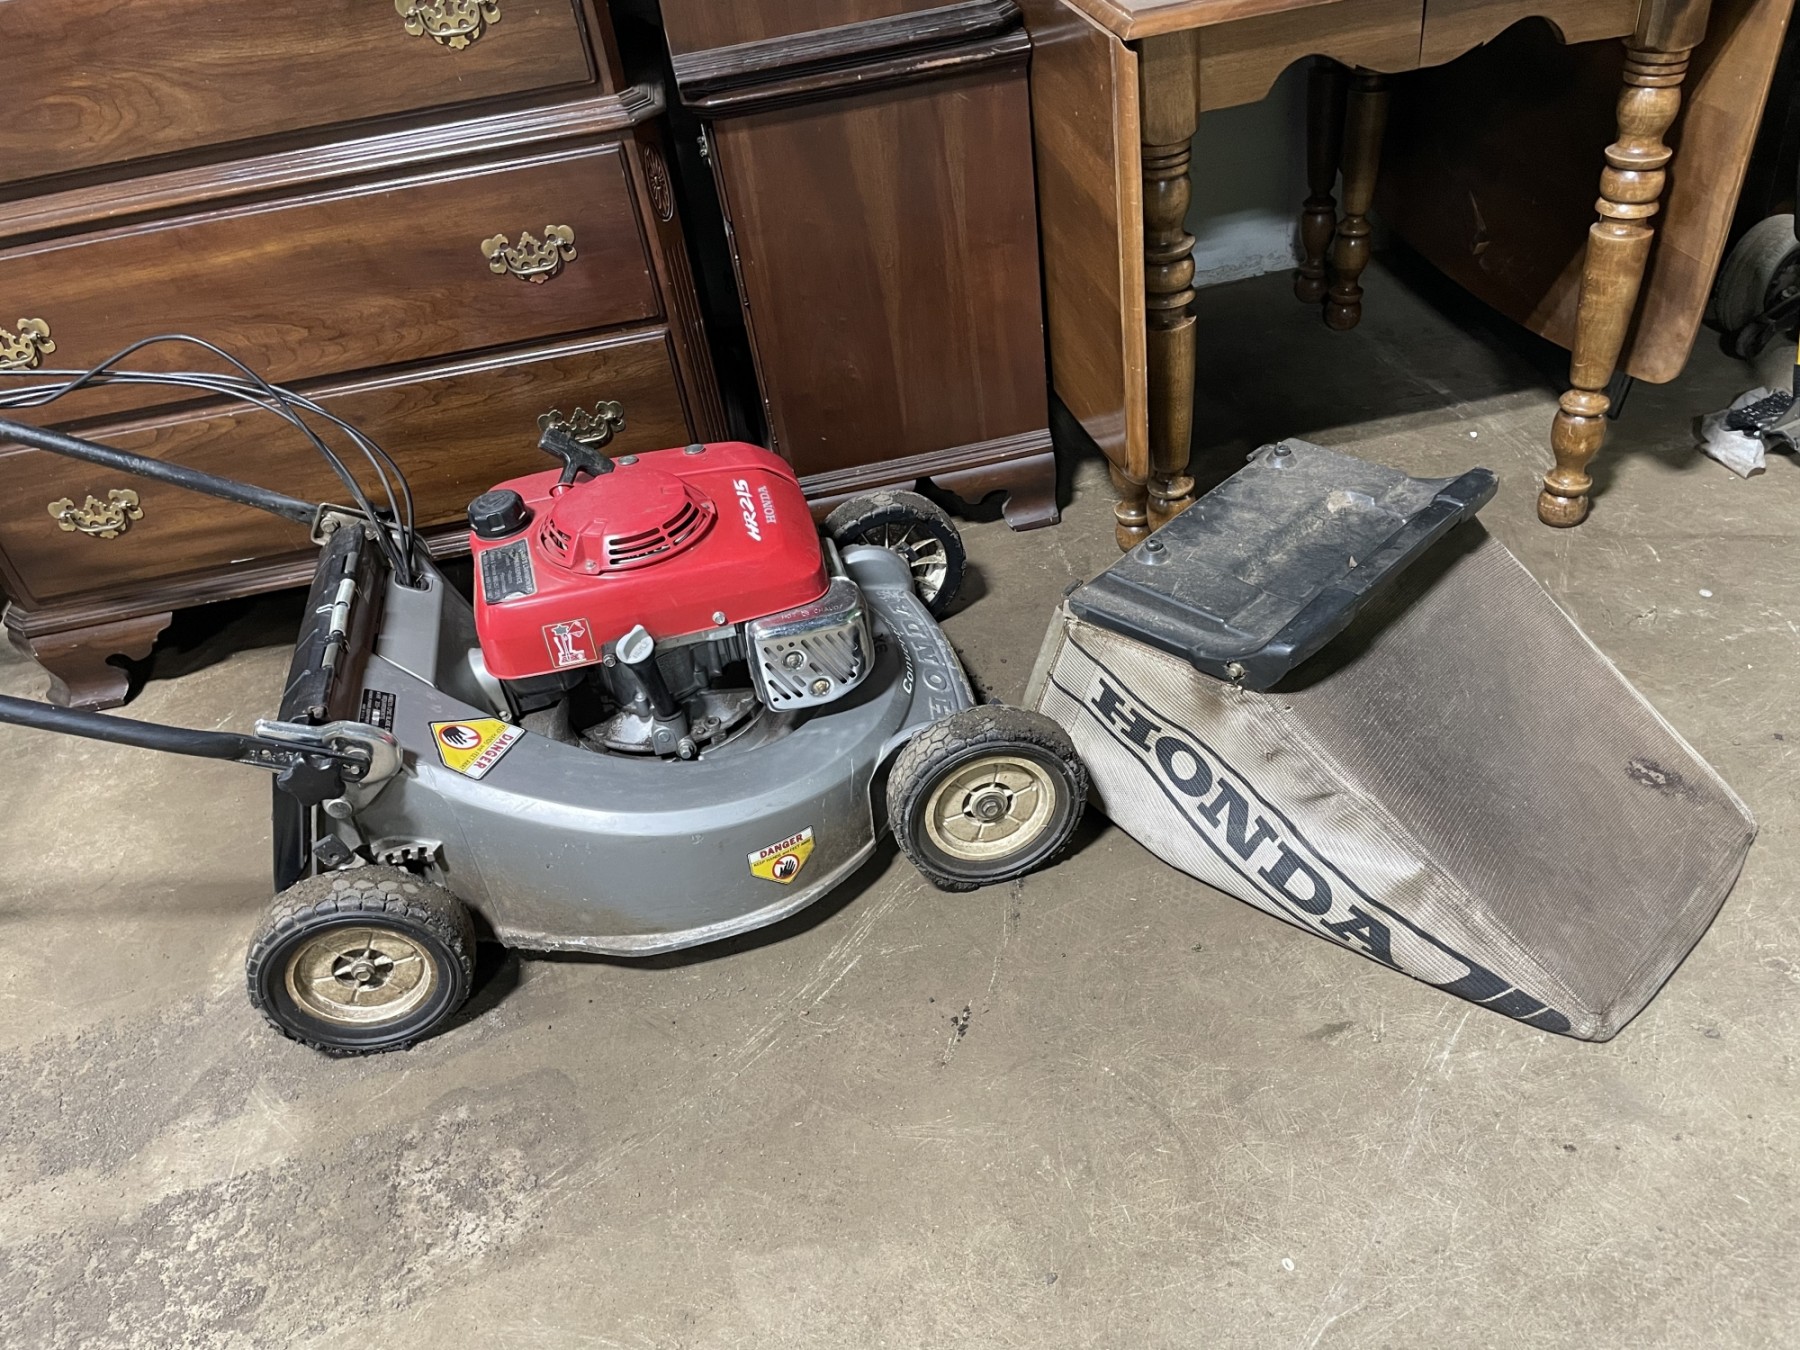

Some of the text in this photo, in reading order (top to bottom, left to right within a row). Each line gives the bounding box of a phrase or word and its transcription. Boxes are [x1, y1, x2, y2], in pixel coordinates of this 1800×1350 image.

[732, 479, 762, 541] HR215
[758, 485, 777, 524] HONDA
[887, 604, 953, 721] HONDA
[474, 734, 514, 769] DANGER
[760, 834, 803, 858] DANGER
[1092, 678, 1403, 970] HONDA
